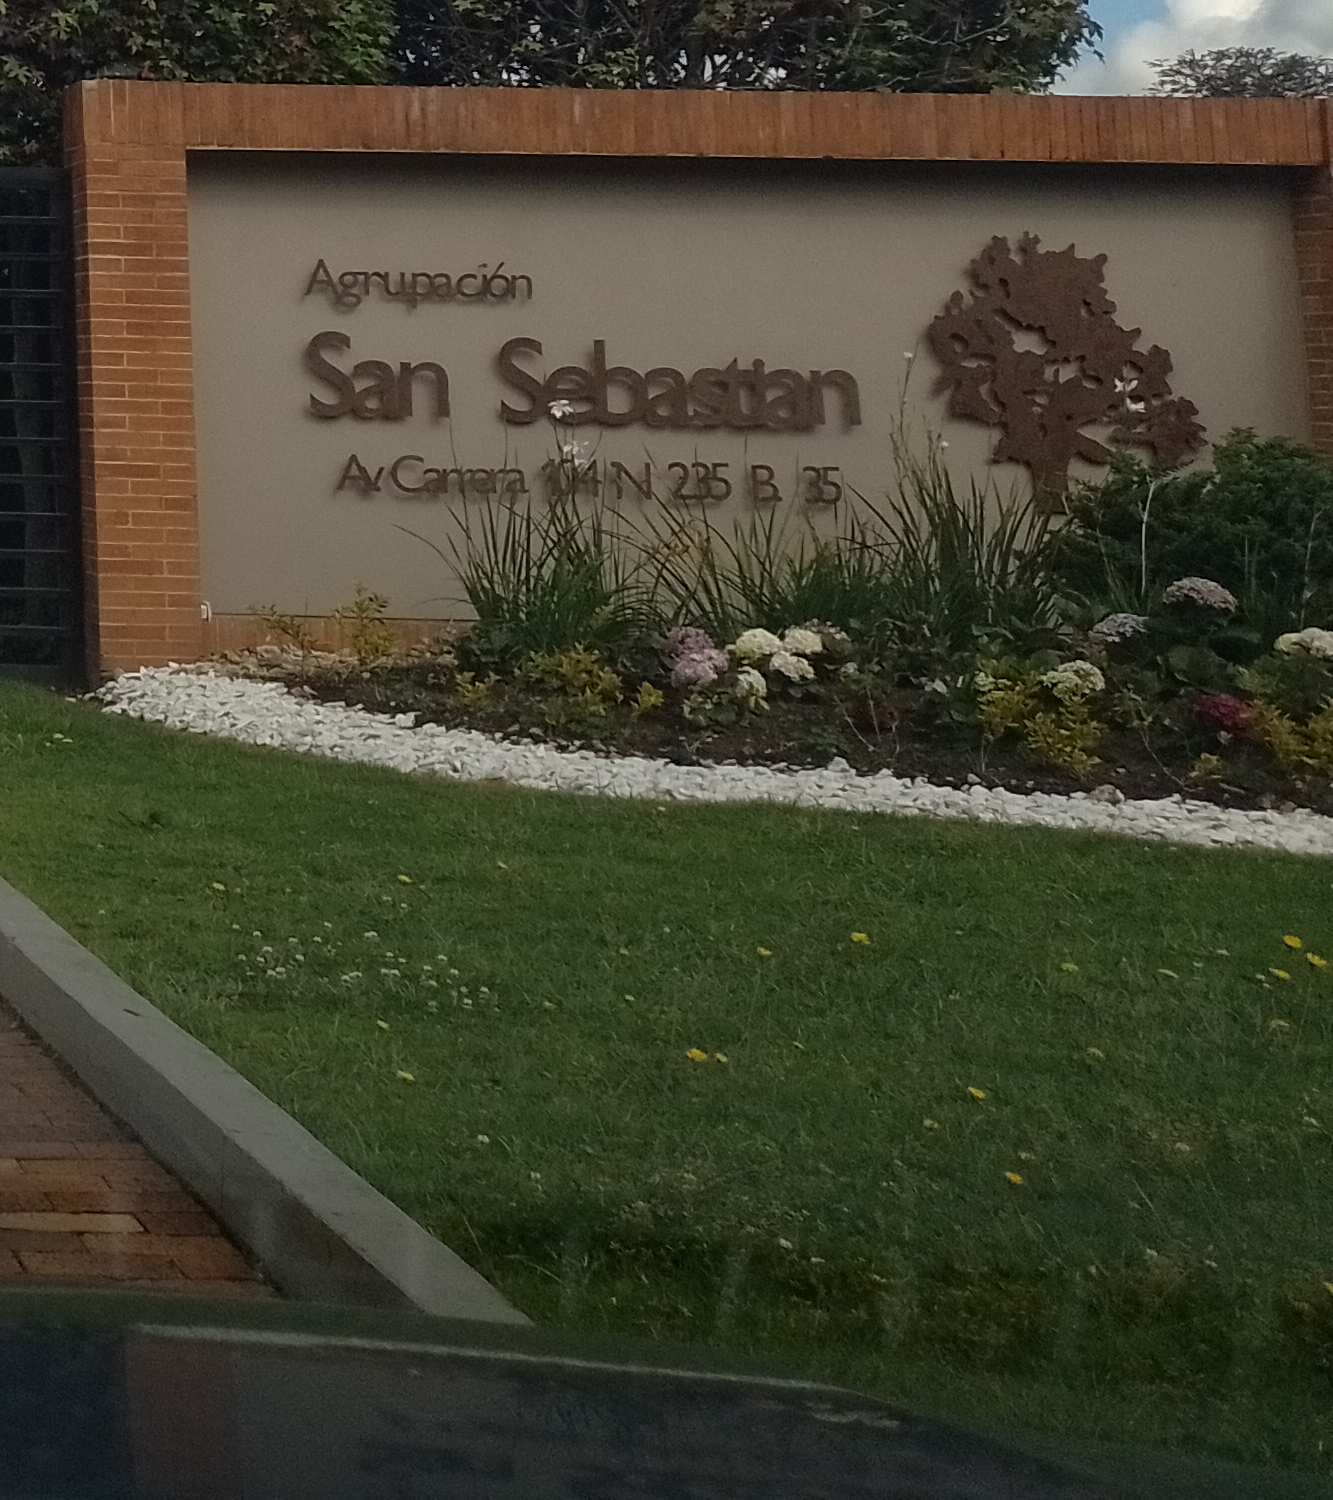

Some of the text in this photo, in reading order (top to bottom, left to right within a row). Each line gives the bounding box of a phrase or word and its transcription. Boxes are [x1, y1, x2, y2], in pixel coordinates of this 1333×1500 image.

[304, 258, 533, 311] Agrupación
[307, 330, 862, 428] San Sebastian
[391, 454, 529, 496] Carrera
[667, 461, 732, 502] 235
[802, 465, 843, 505] 35
